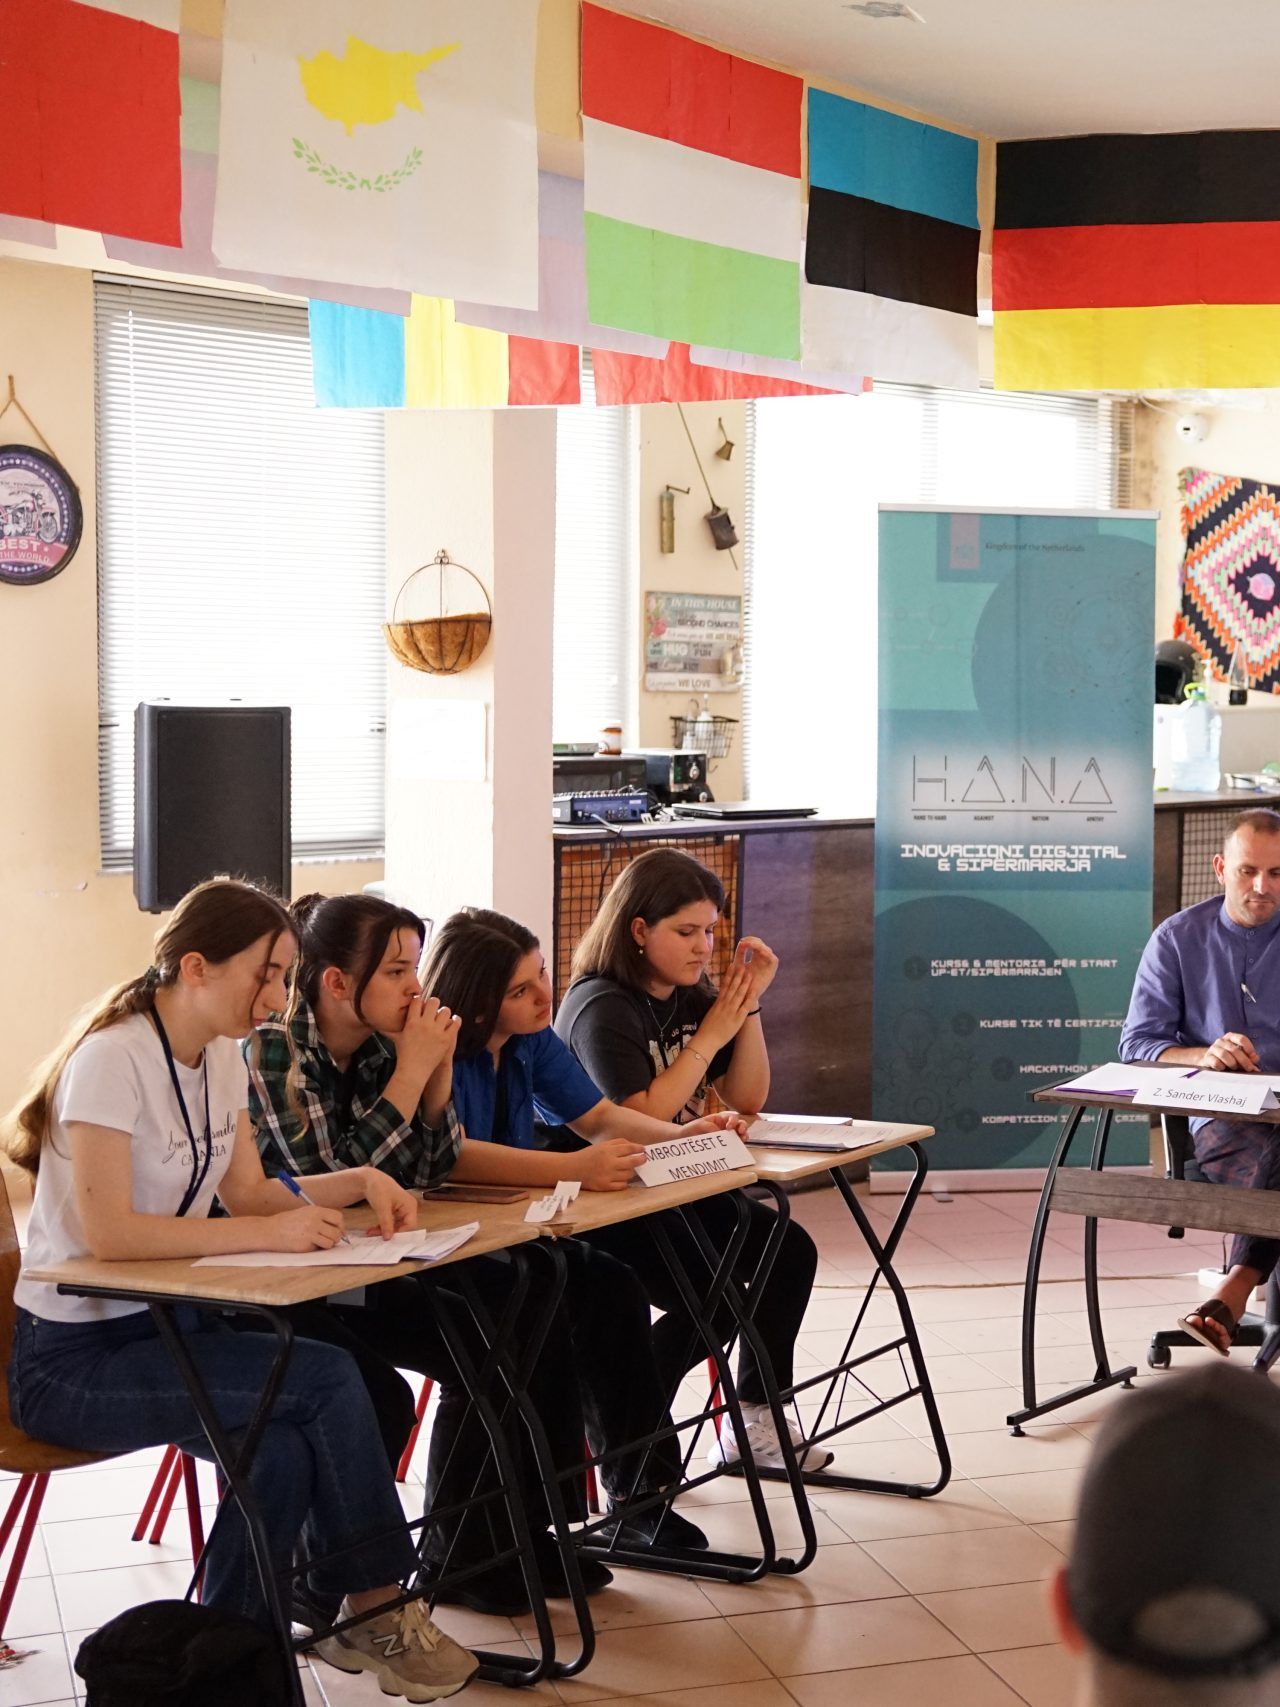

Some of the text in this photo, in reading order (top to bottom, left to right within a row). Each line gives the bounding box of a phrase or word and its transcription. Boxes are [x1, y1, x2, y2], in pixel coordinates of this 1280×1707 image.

[18, 552, 50, 563] WORLD
[901, 845, 1127, 859] INOVACIONI DIGJITAL
[938, 859, 950, 870] &
[985, 959, 1046, 968] MENTORIM
[1081, 959, 1118, 968] START
[980, 1019, 1016, 1028] KURSE
[1021, 1019, 1043, 1028] TIK
[1065, 1019, 1124, 1028] CERTIFIK
[1020, 1065, 1087, 1073] HACKATHON
[1153, 1087, 1248, 1107] Z. Sander Vlashaj
[982, 1115, 1057, 1123] KOMPETICION
[718, 1135, 727, 1147] E
[668, 1157, 730, 1180] MENDIMIT
